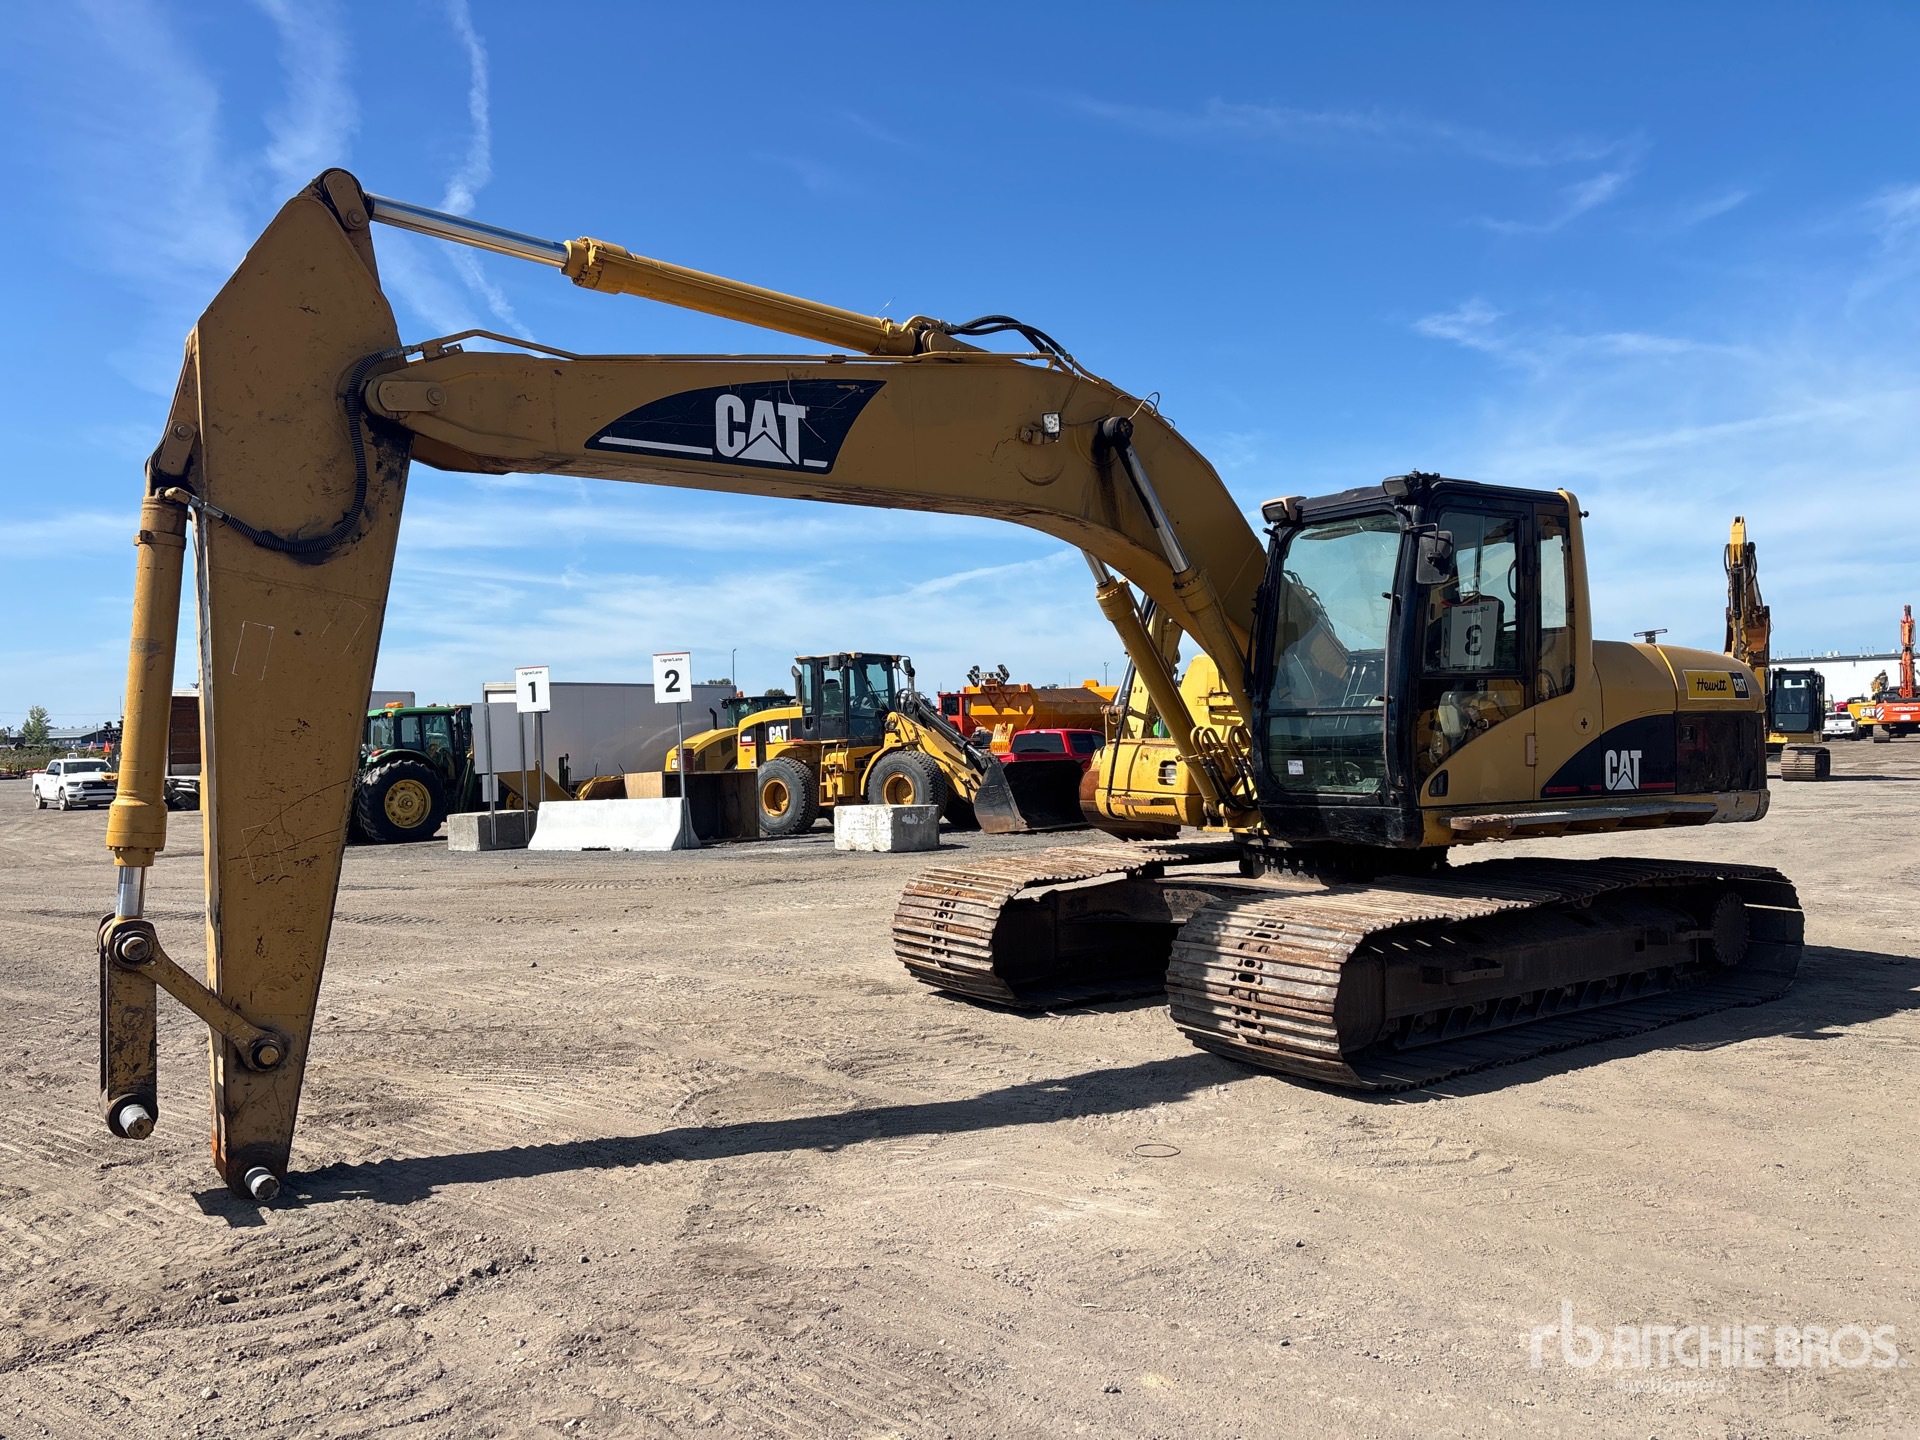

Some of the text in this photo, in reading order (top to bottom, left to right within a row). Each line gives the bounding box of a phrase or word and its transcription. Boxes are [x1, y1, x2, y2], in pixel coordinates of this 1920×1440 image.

[715, 394, 806, 465] CAT
[528, 681, 537, 703] 1
[664, 669, 681, 693] 2
[1696, 677, 1728, 691] Hewitt
[768, 725, 789, 743] CAT
[1605, 749, 1643, 791] CAT
